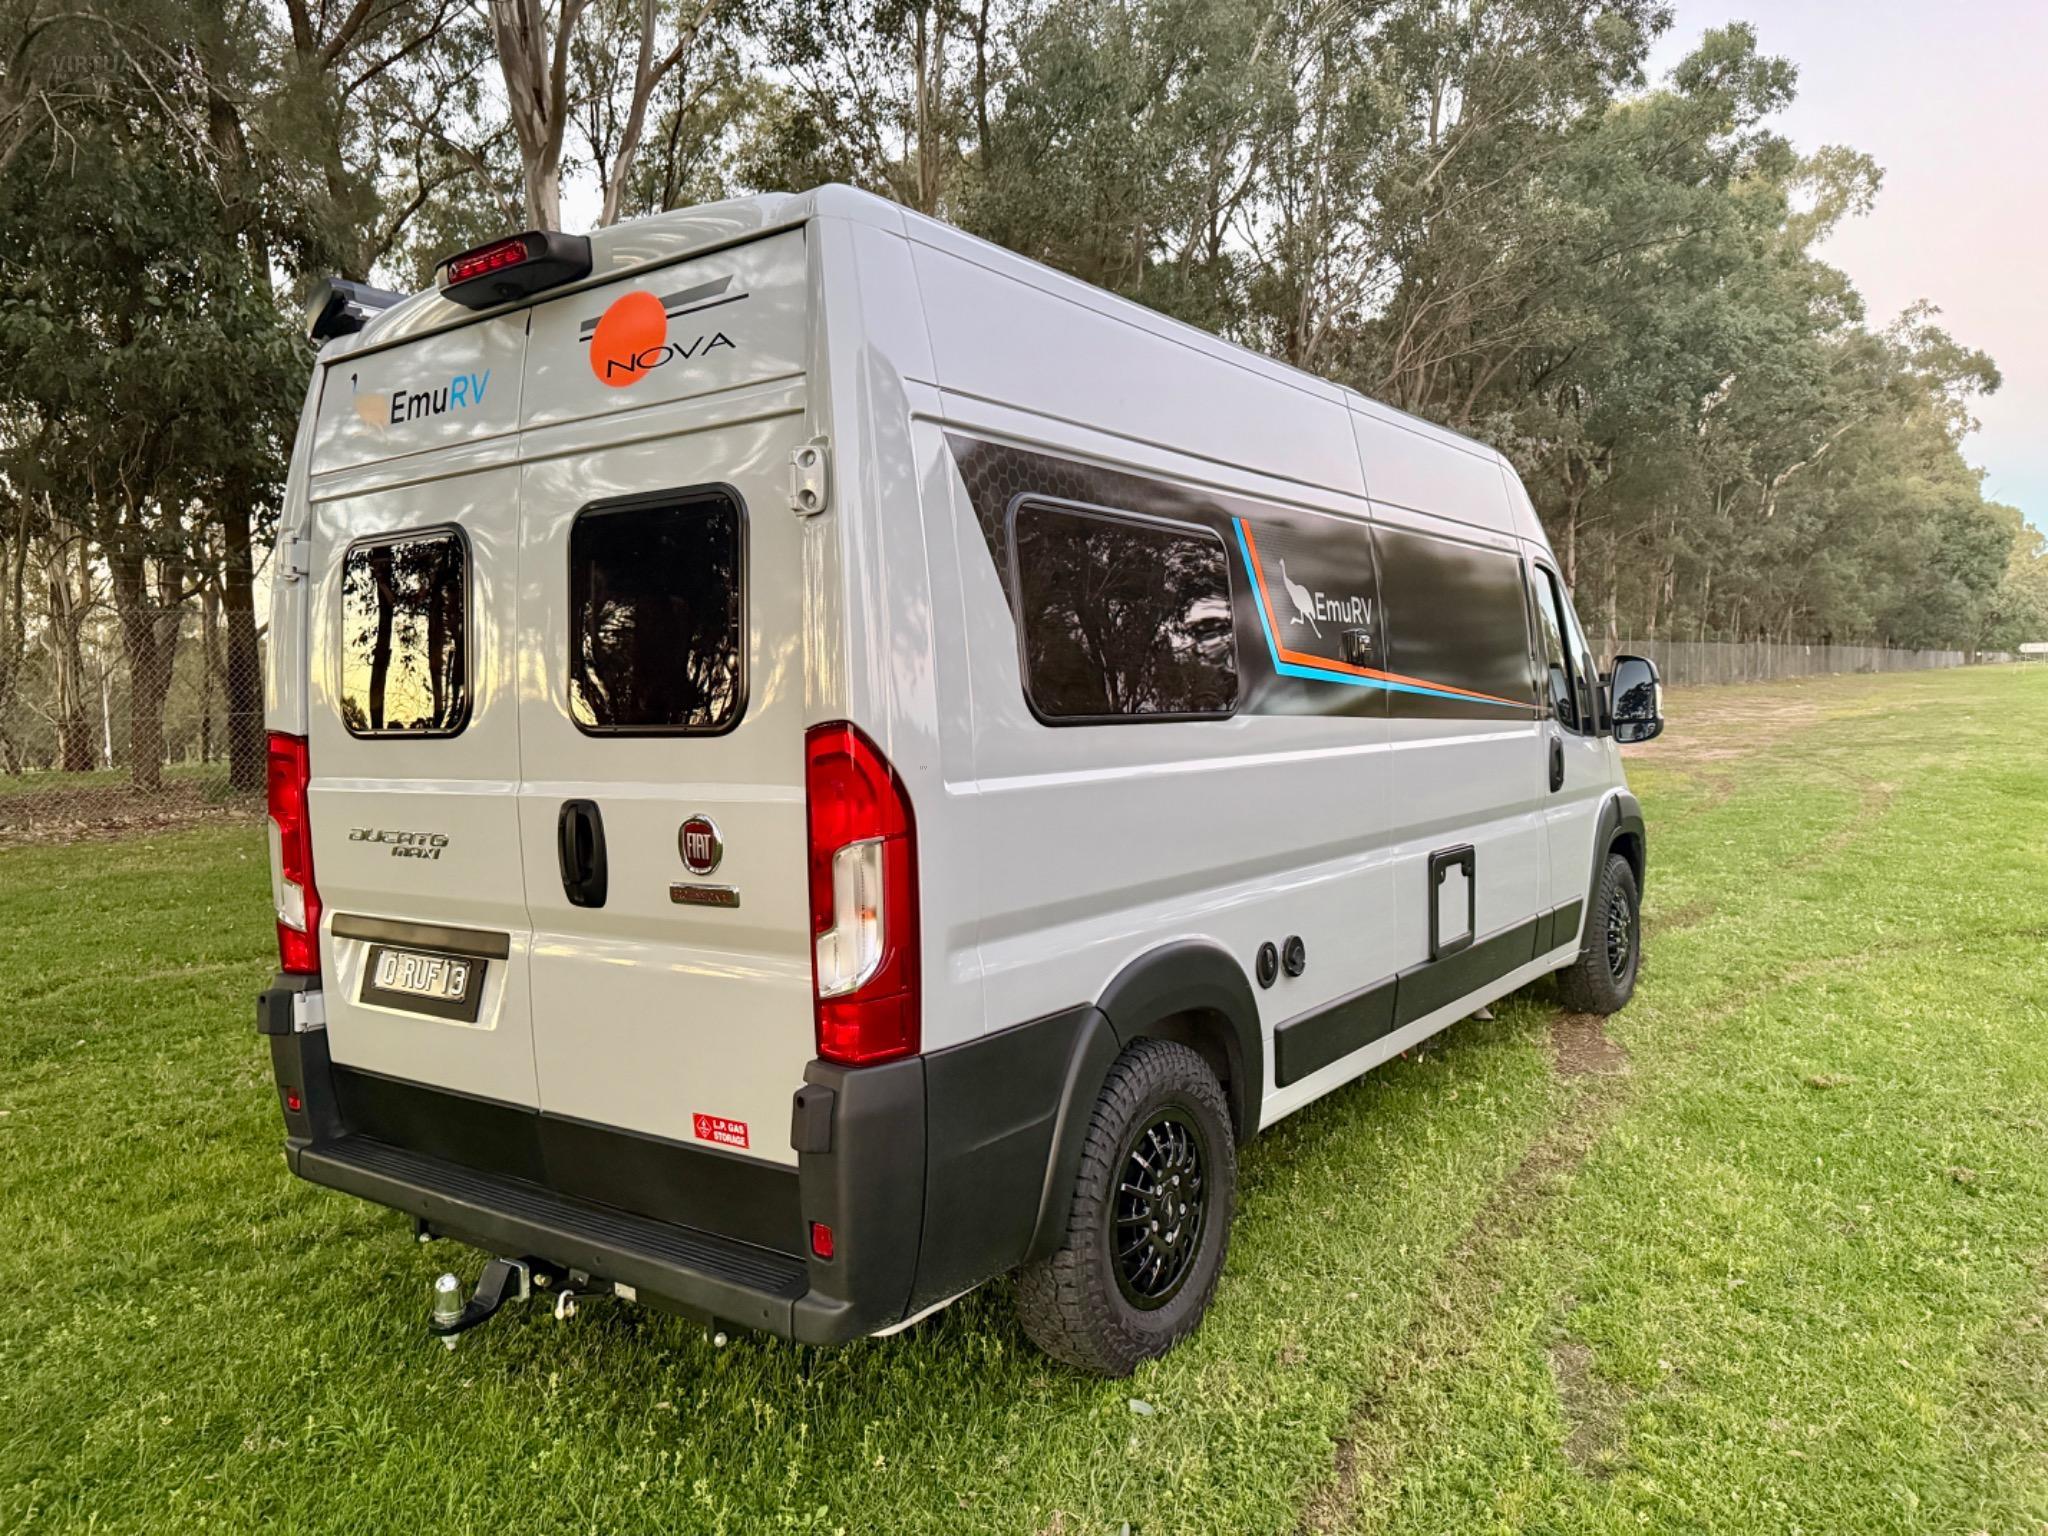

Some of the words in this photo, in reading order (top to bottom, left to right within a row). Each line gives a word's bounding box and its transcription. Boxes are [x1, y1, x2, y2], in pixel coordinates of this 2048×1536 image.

[606, 331, 736, 378] NOVA
[391, 367, 491, 424] EmuRV
[1314, 591, 1372, 625] EmuRV
[686, 832, 711, 860] FIAT
[713, 1130, 746, 1147] STORAGE
[728, 1122, 745, 1135] GAS
